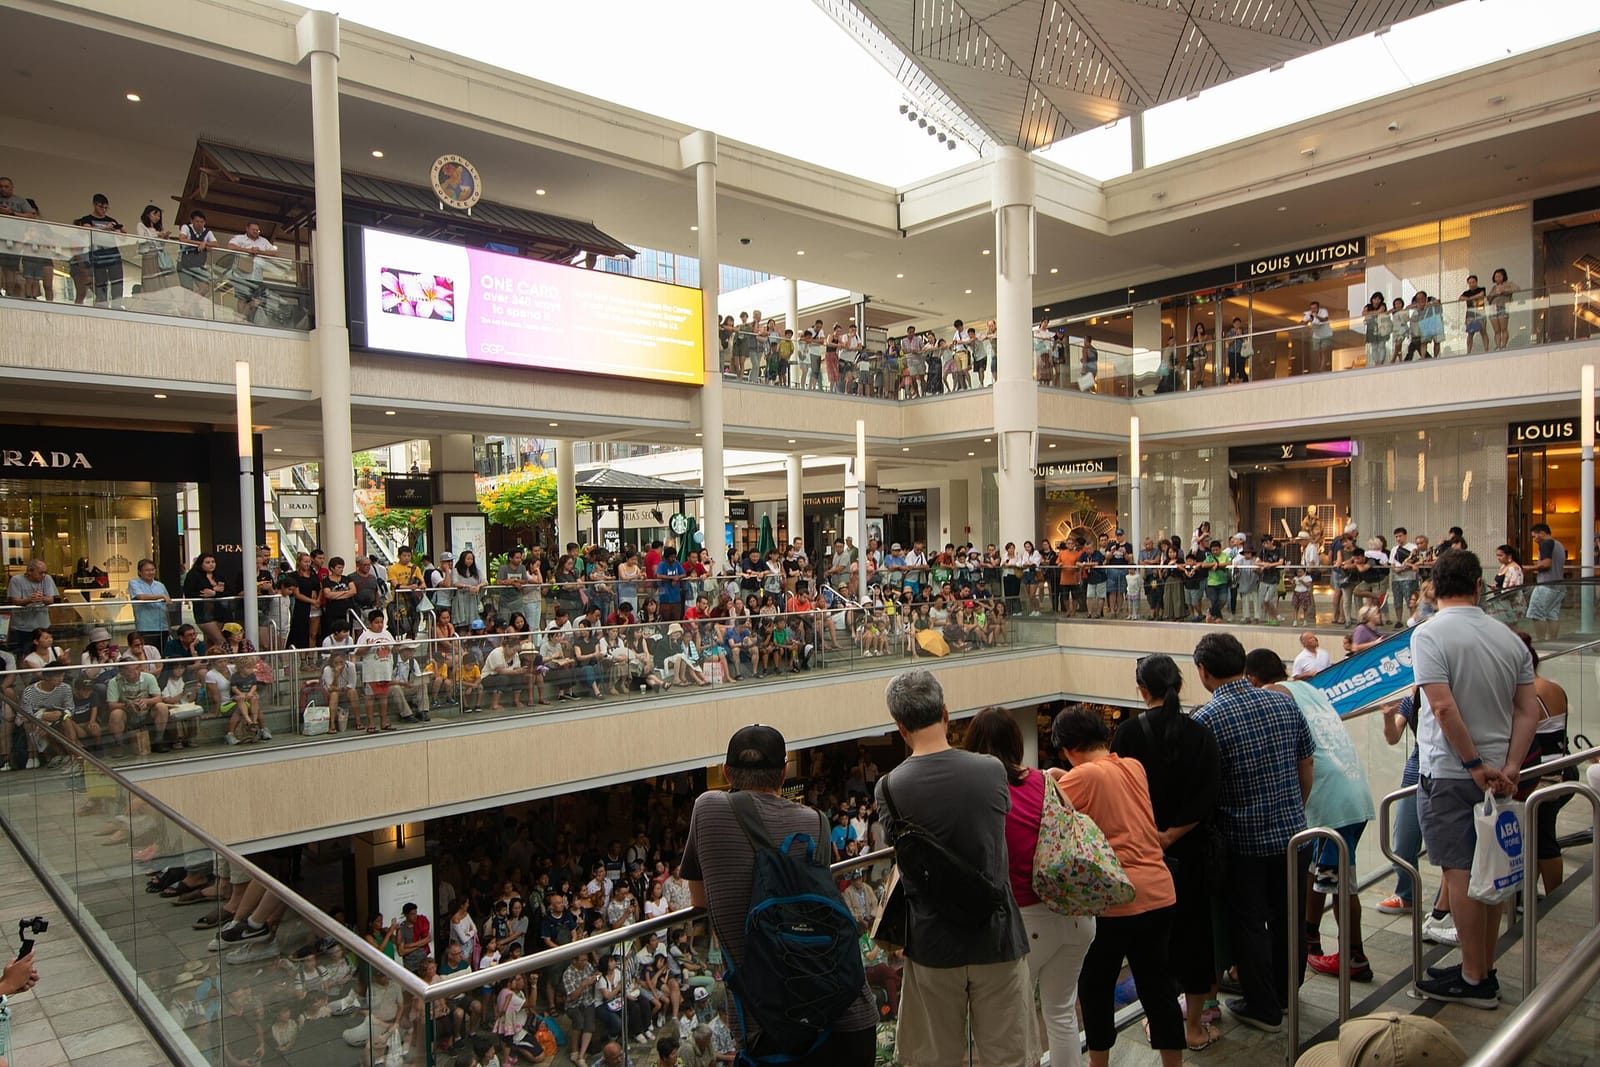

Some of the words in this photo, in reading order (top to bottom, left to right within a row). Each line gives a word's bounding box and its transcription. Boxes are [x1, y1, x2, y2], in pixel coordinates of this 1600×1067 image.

[434, 156, 479, 180] HONOLULU
[435, 183, 468, 206] COFFEE
[1250, 256, 1290, 275] LOUIS
[1295, 241, 1359, 266] VUITTON
[480, 274, 513, 292] ONE
[517, 280, 559, 299] CARD
[483, 291, 508, 303] over
[492, 304, 504, 315] to
[507, 307, 541, 321] spend
[1517, 422, 1573, 440] LOUIS
[1, 449, 92, 468] RADA
[1033, 465, 1055, 477] OUIS
[1057, 461, 1104, 475] VUITTON
[283, 502, 313, 510] PRADA
[821, 496, 841, 504] VENET
[624, 512, 640, 521] RIA'S
[216, 544, 243, 553] PRA
[1500, 820, 1520, 840] ABC
